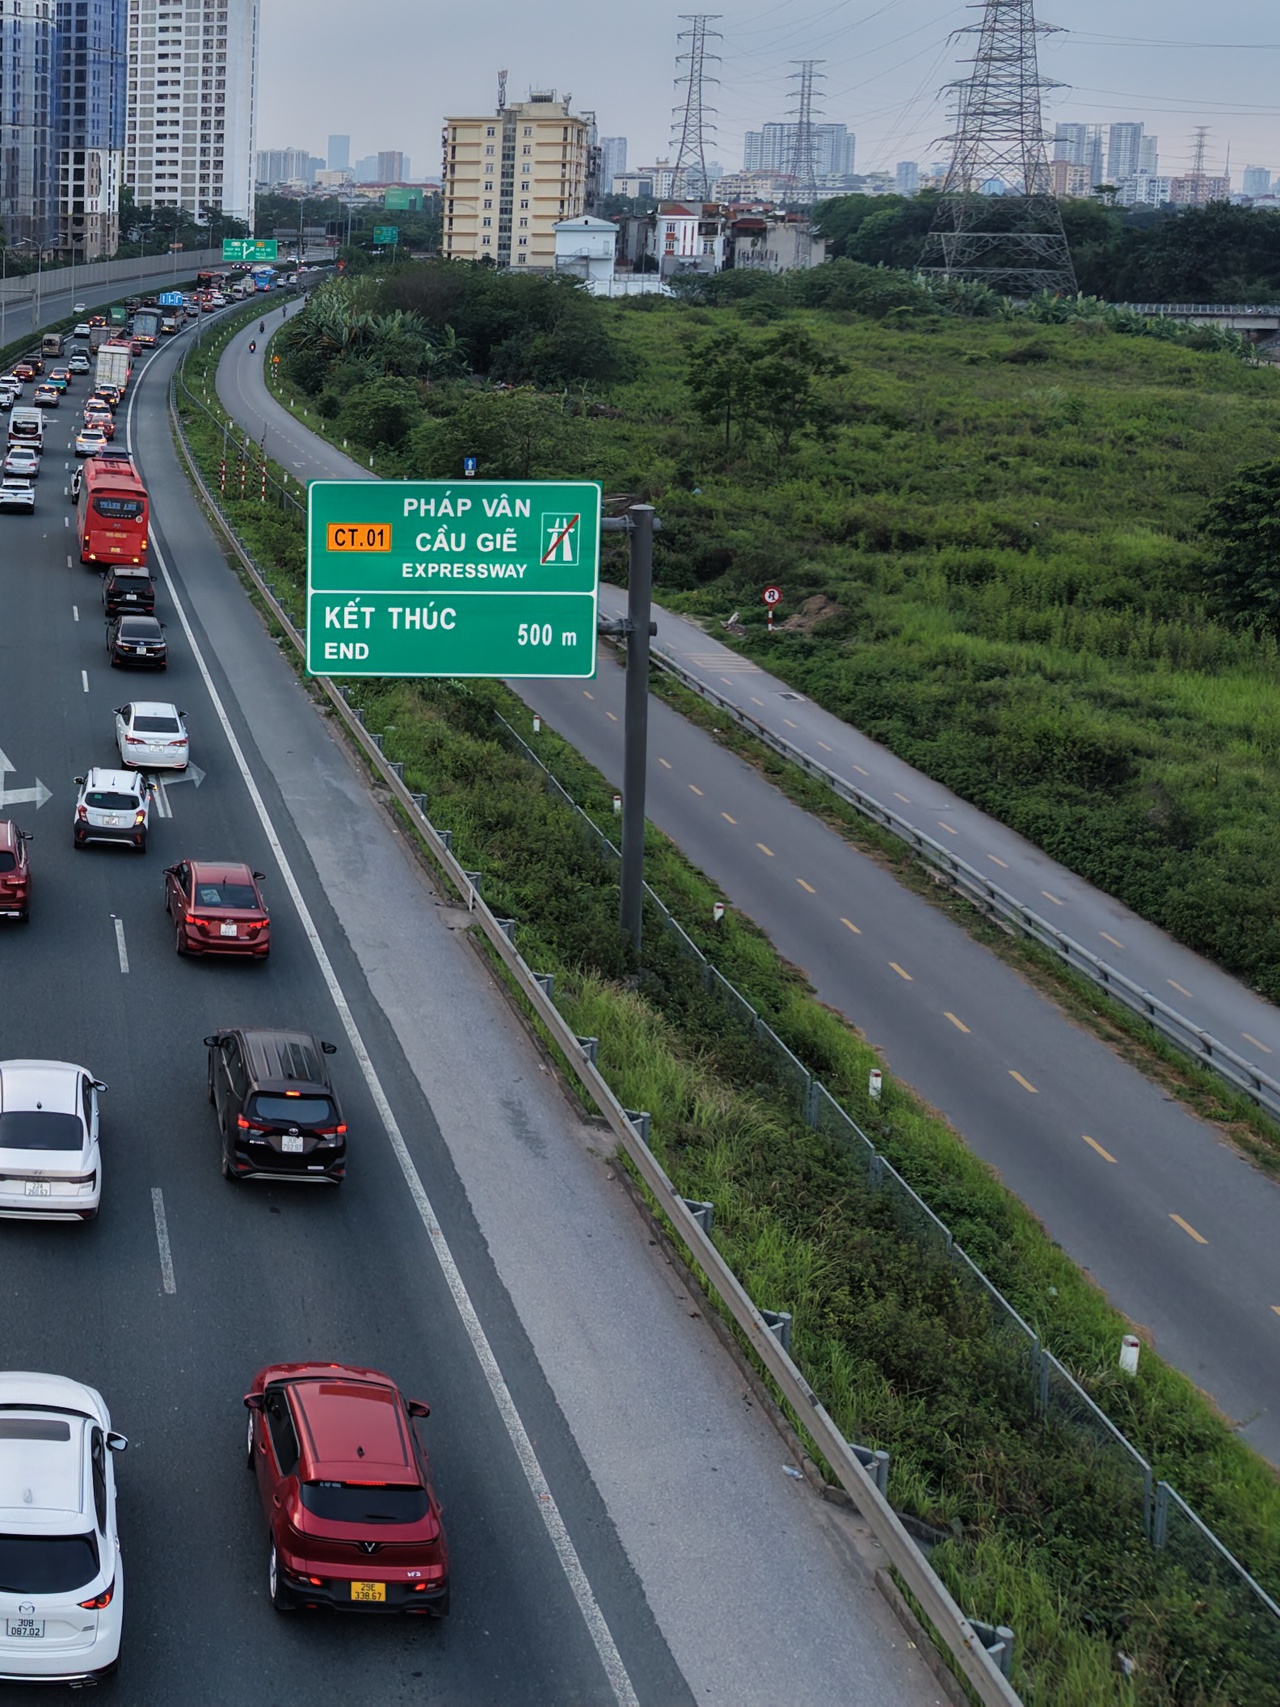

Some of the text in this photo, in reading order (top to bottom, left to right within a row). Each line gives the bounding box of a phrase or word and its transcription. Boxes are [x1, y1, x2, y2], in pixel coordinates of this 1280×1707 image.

[403, 491, 531, 518] PHÁP VÂN
[334, 528, 385, 547] CT.01
[415, 524, 518, 552] CẦU GIẼ
[402, 563, 528, 579] EXPRESSWAY
[324, 597, 457, 630] KẾT THÚC
[517, 623, 577, 646] 500 m
[324, 642, 369, 660] END
[354, 1591, 382, 1601] 338.67
[361, 1584, 376, 1592] 29E
[11, 1627, 40, 1636] 087.02
[18, 1618, 34, 1628] 30B
